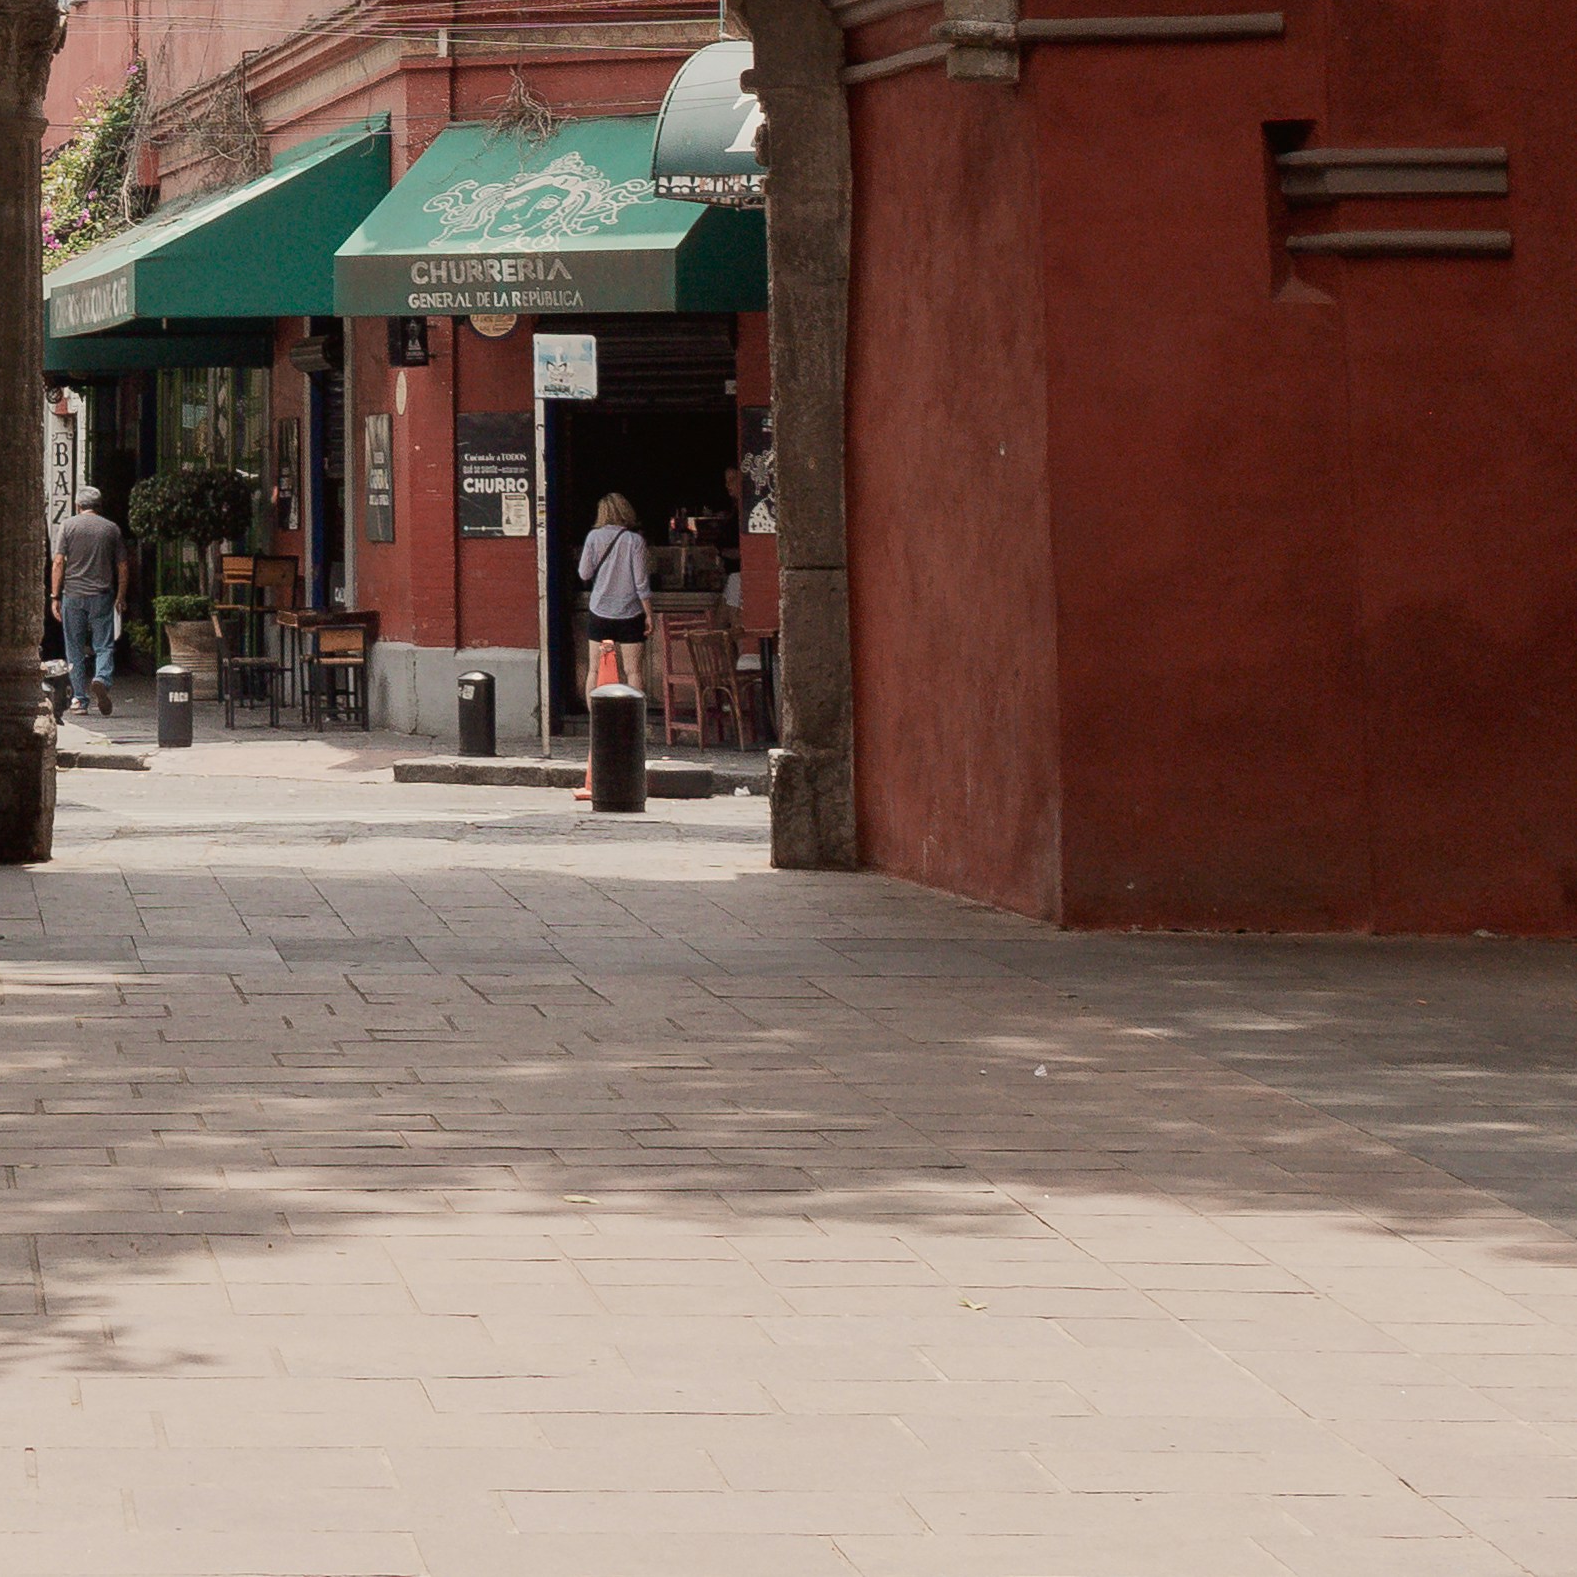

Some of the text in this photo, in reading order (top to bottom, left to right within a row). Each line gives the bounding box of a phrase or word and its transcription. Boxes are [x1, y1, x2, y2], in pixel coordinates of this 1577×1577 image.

[407, 291, 473, 309] GENERAL
[476, 291, 491, 307] DE
[493, 291, 509, 308] LA
[463, 477, 529, 494] CHURRO
